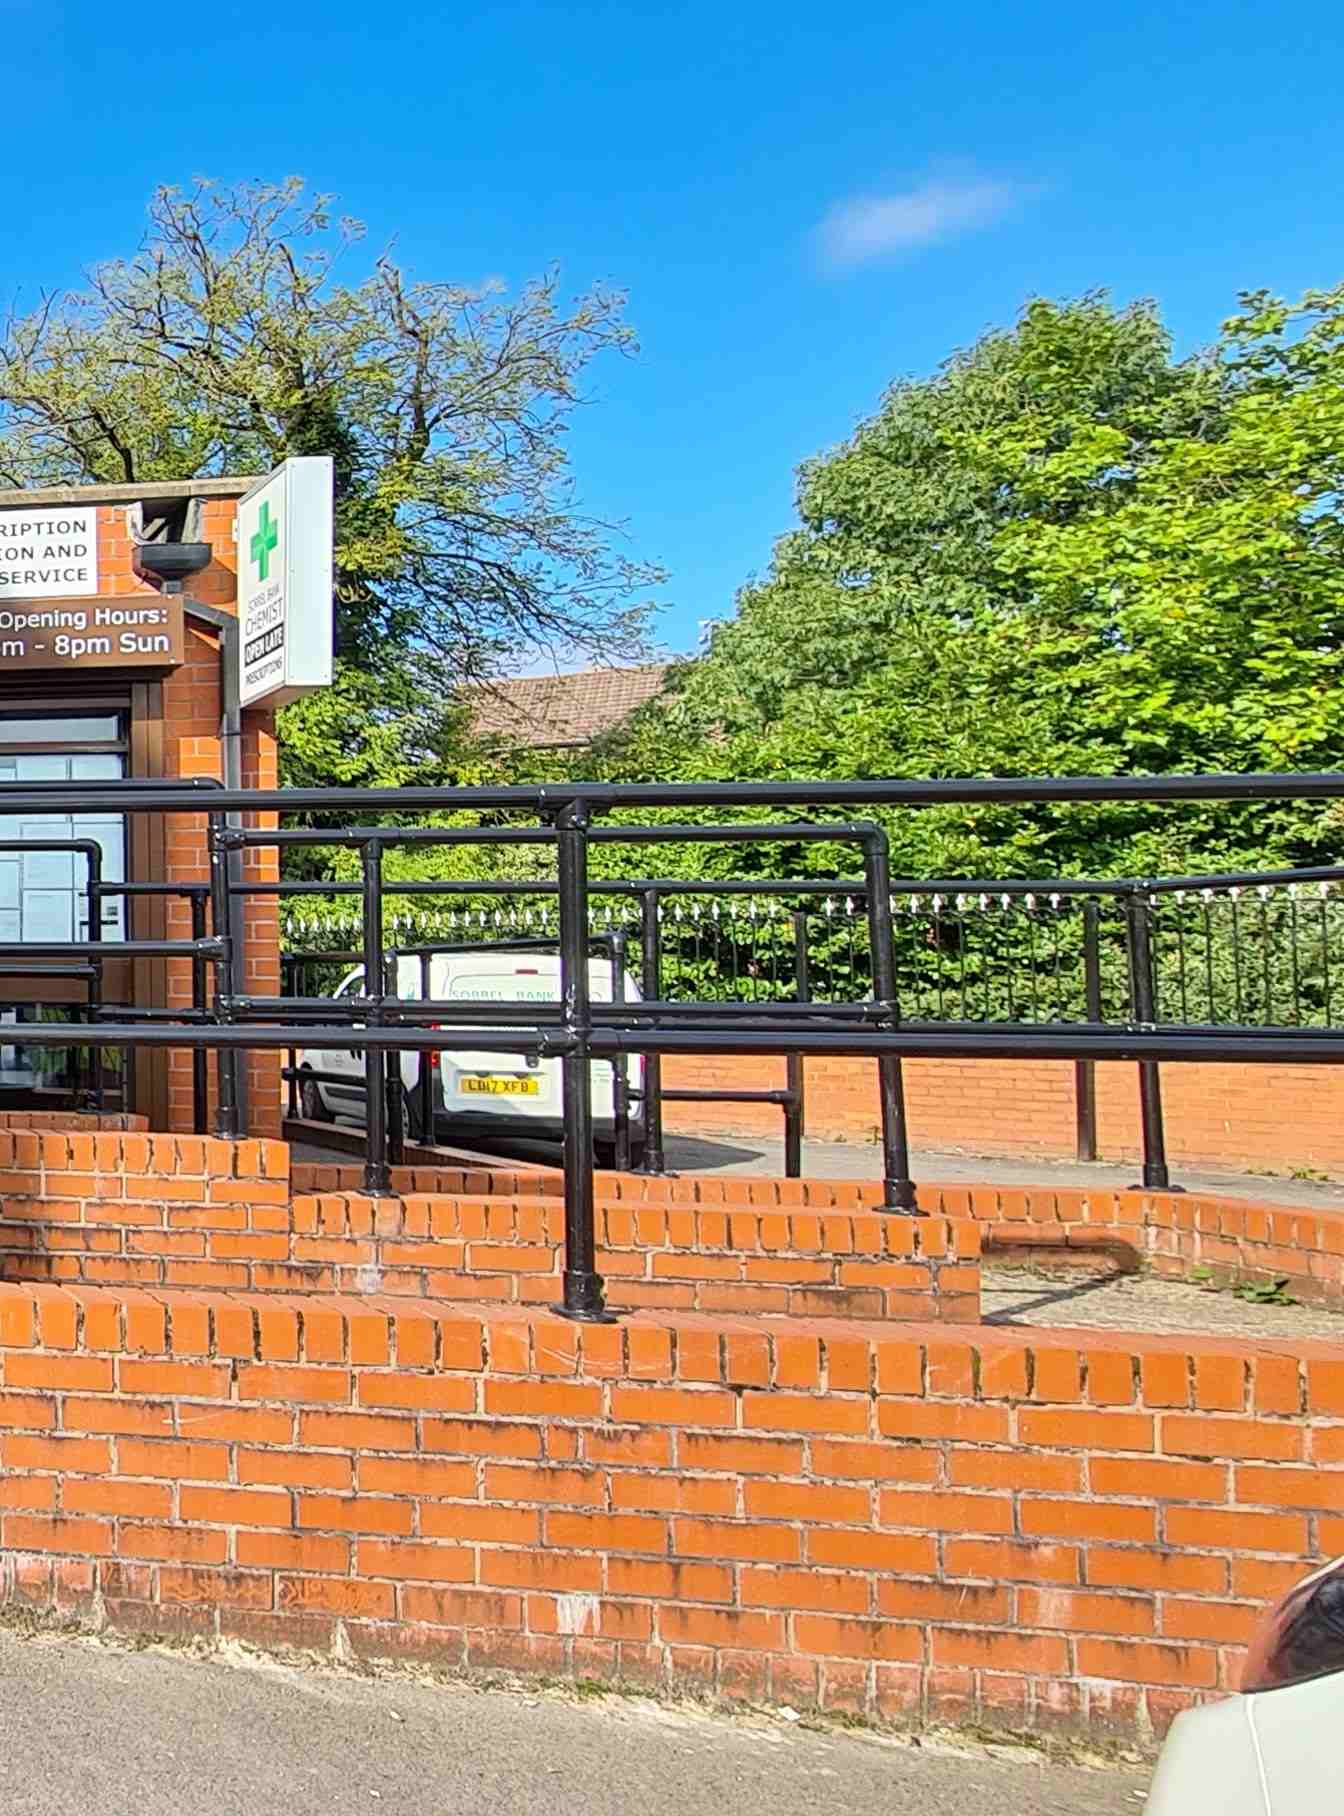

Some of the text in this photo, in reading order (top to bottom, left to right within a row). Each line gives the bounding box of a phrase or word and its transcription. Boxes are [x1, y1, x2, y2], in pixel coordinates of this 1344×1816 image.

[42, 543, 88, 559] AND
[94, 607, 168, 626] Hours:
[245, 596, 283, 636] CHEMIST
[54, 634, 111, 659] 8pm
[119, 632, 169, 653] Sun
